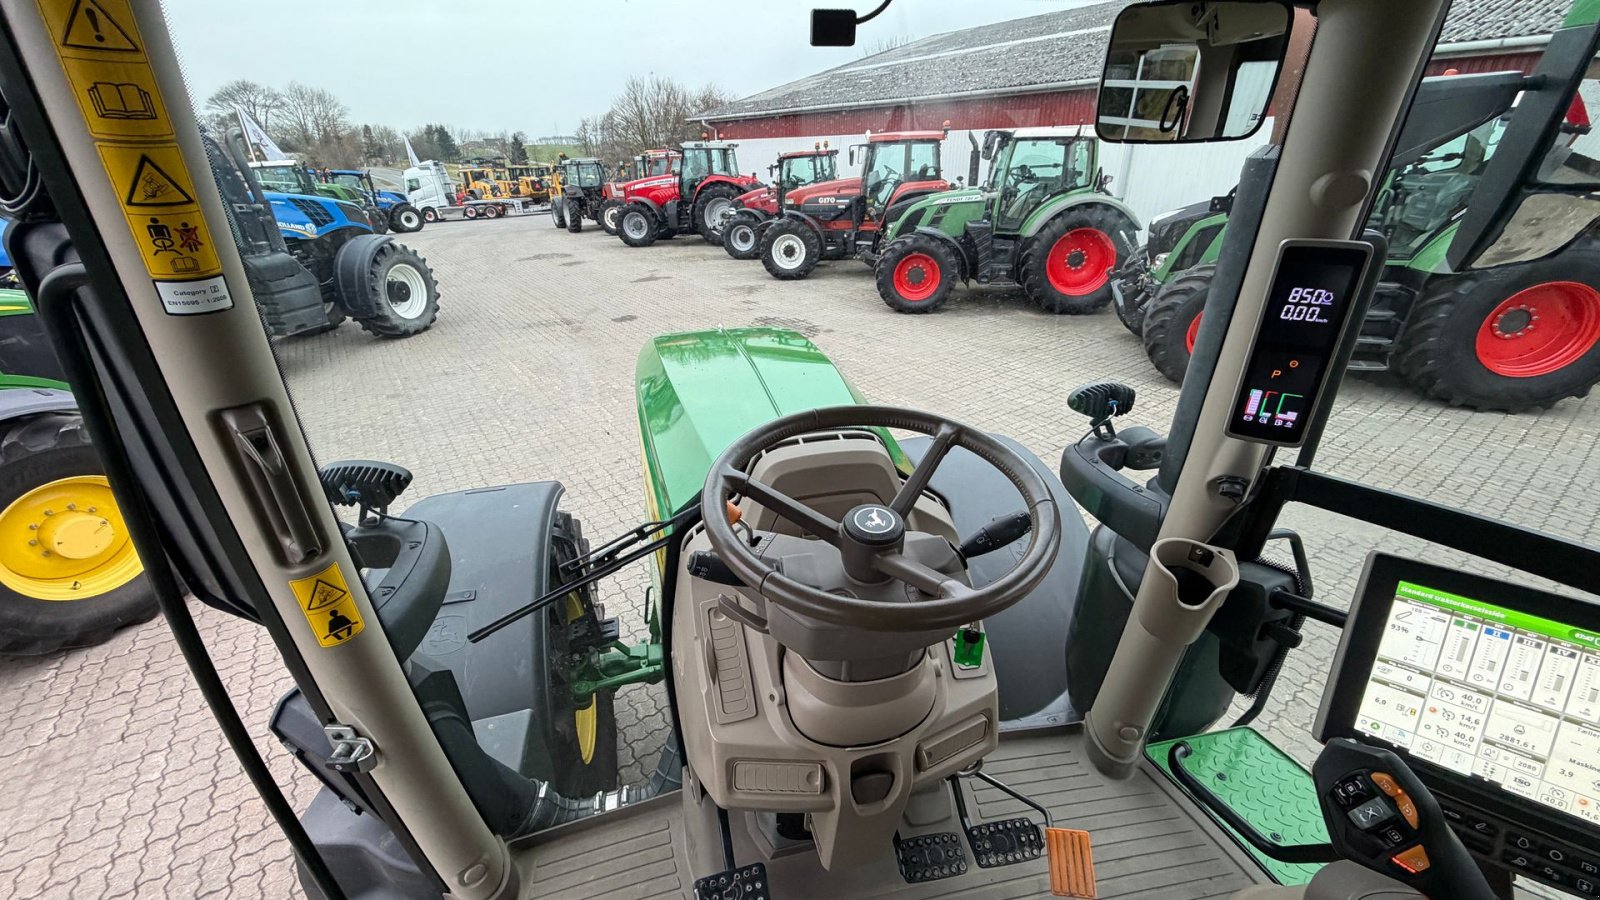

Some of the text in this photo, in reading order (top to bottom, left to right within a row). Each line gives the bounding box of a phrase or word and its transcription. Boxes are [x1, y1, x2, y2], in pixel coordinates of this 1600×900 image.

[173, 288, 207, 297] Category
[1288, 287, 1326, 304] 850
[1271, 369, 1281, 379] P
[1400, 585, 1434, 600] Standard
[1391, 623, 1409, 634] 93%
[1557, 646, 1571, 656] IV
[1460, 701, 1478, 710] km/t
[1459, 720, 1477, 731] km/t
[1453, 738, 1471, 749] km/t
[1517, 760, 1537, 772] 2080
[1513, 776, 1531, 787] ISO
